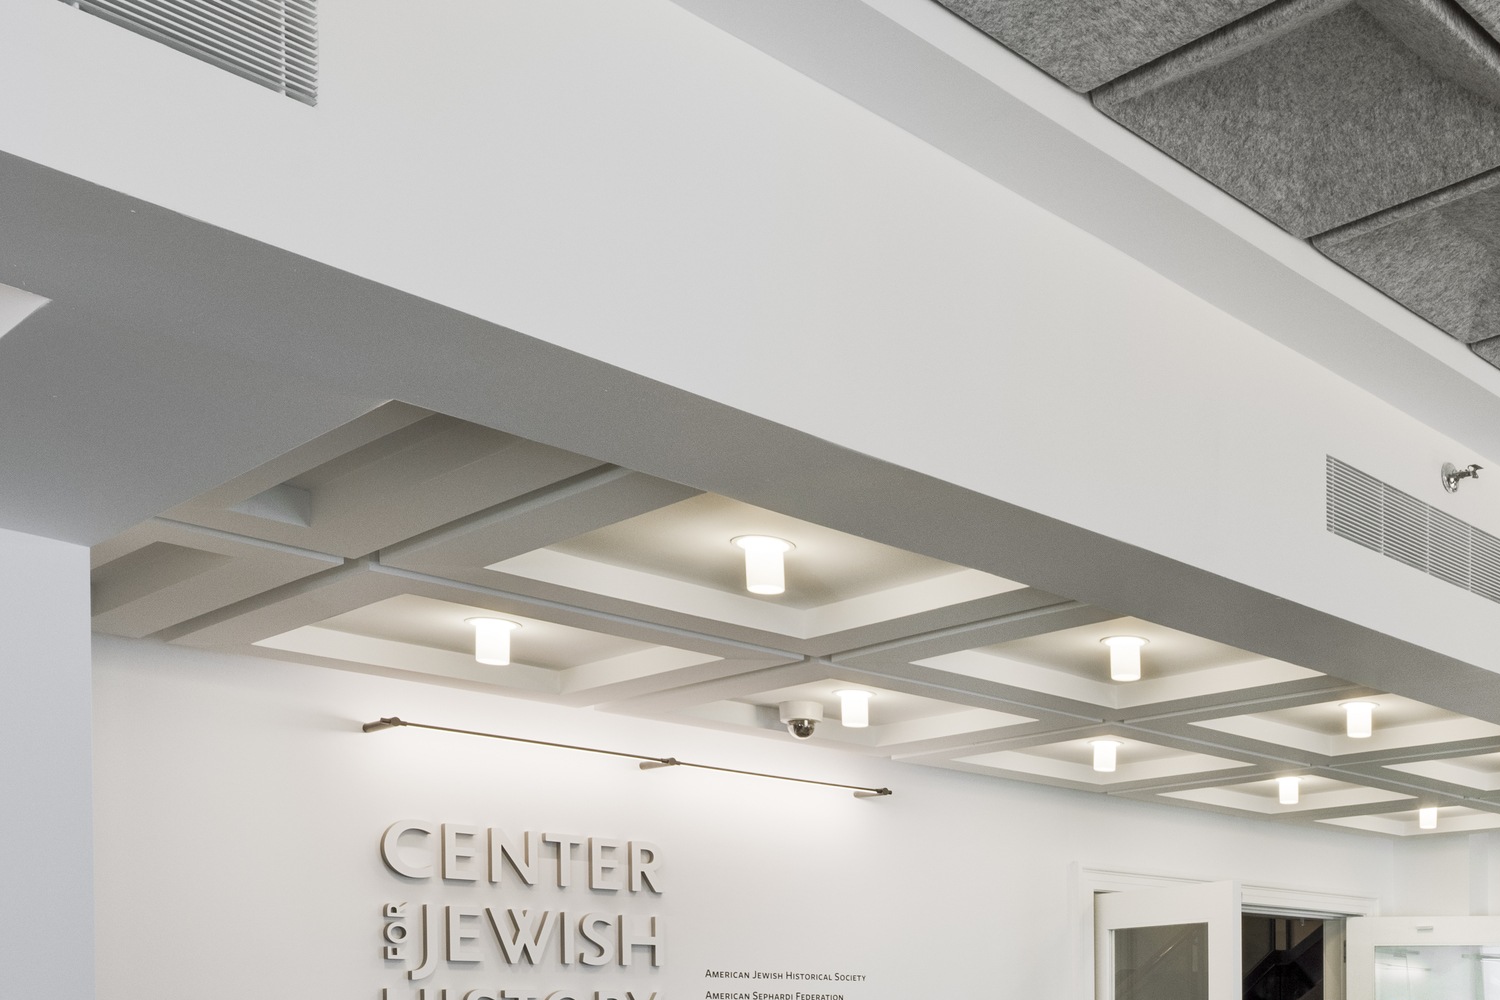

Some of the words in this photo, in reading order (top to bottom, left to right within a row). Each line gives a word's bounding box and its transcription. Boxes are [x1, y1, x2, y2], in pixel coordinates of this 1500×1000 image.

[380, 819, 664, 895] CENTER
[383, 902, 409, 960] FOR
[408, 903, 665, 981] JEWISH
